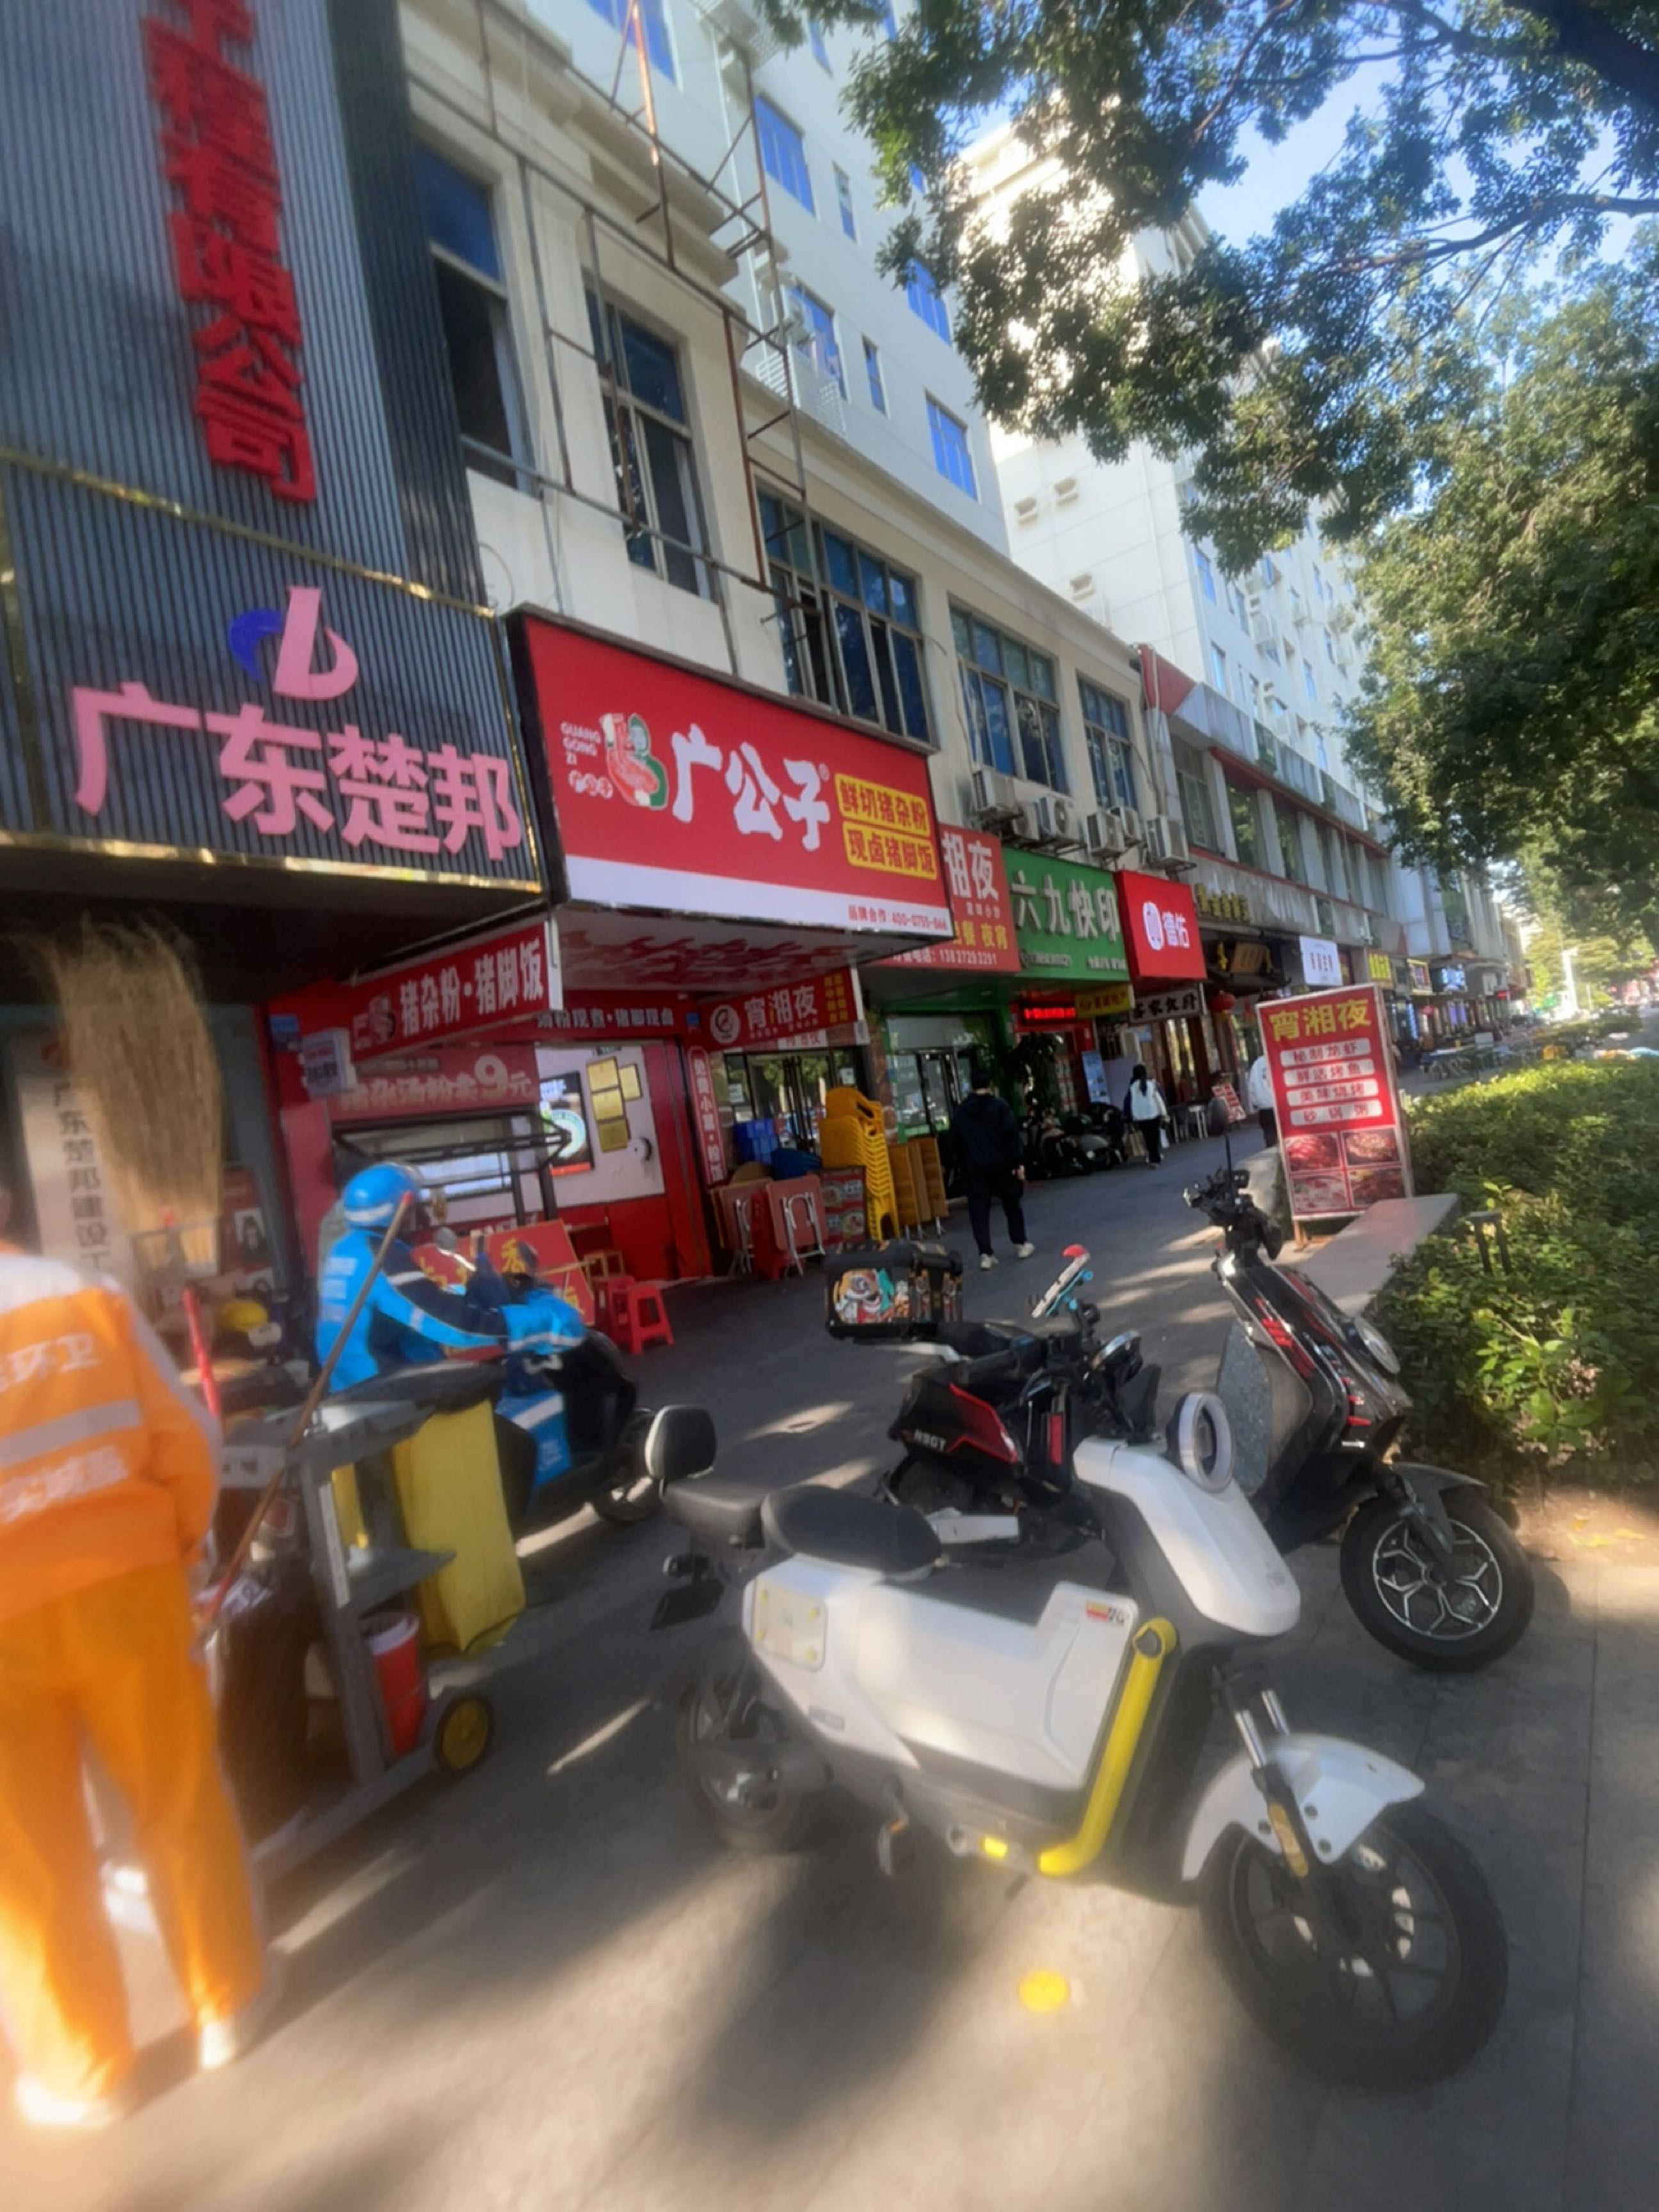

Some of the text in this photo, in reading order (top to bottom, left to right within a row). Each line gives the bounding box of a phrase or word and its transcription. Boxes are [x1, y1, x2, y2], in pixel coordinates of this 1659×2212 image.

[72, 681, 522, 862] 广东楚邦
[671, 723, 830, 851] 广公子
[839, 779, 928, 833] 鲜切猪杂粉
[846, 828, 935, 874] 现卤猪脚饭
[1011, 870, 1120, 942] 六九快印
[1269, 998, 1372, 1042] 宵湘夜
[1297, 1062, 1361, 1082] 鲜活烤鱼
